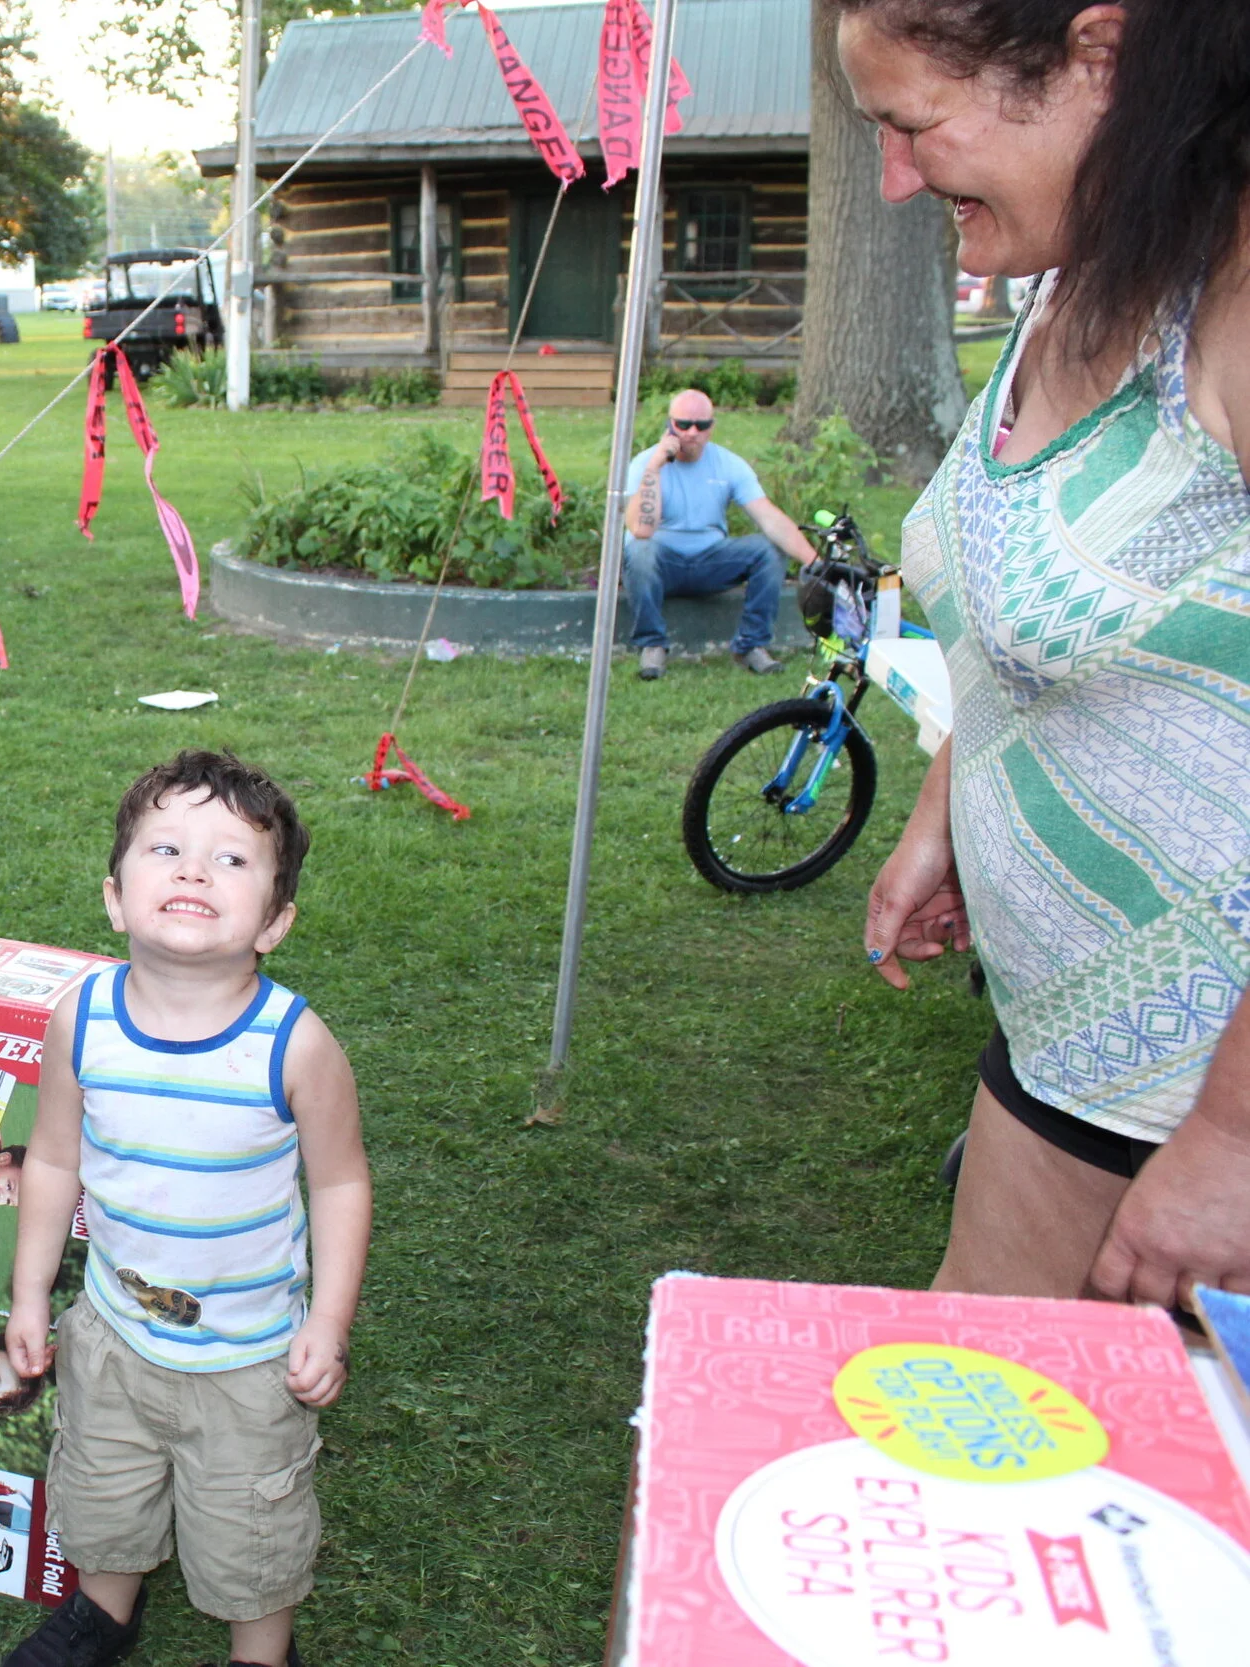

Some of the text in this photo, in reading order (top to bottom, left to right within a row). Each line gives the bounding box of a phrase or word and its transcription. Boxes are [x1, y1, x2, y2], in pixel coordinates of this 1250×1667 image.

[41, 1562, 65, 1597] Fold
[781, 1509, 855, 1596] SOFA
[854, 1476, 950, 1664] EXPLORER
